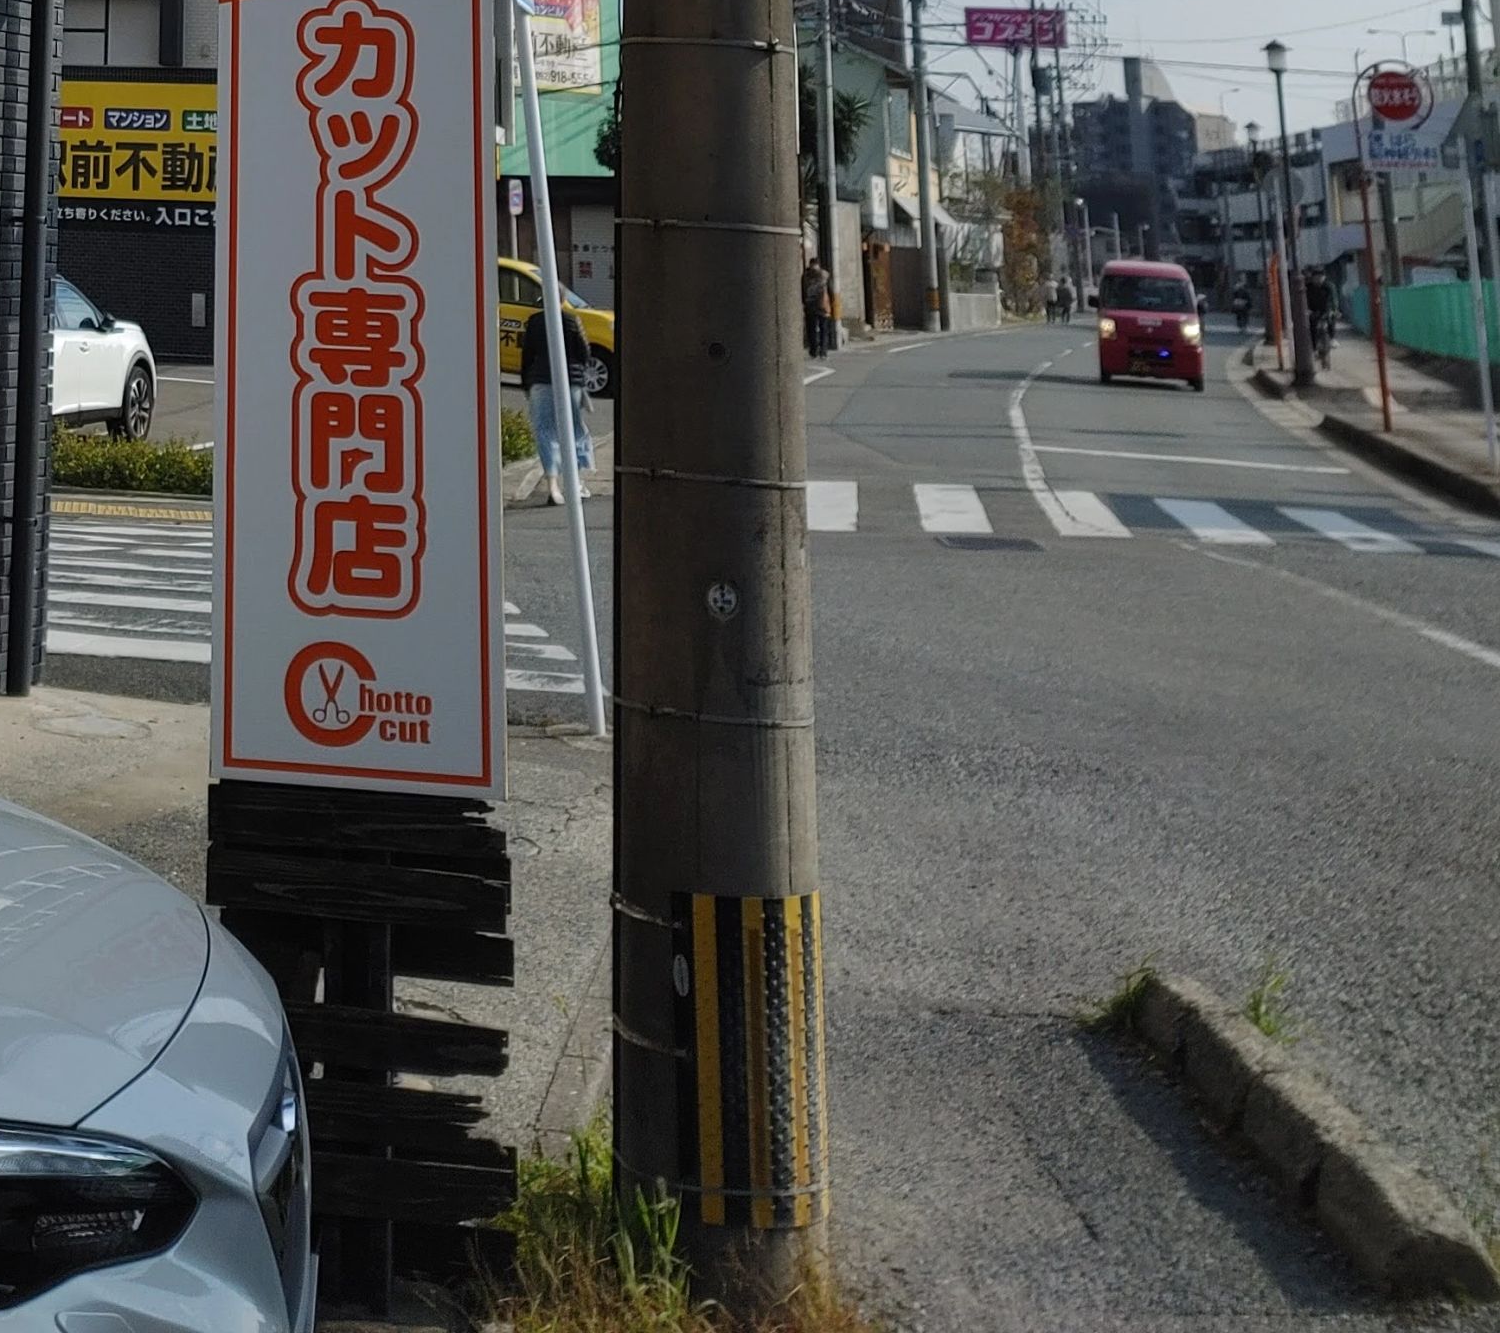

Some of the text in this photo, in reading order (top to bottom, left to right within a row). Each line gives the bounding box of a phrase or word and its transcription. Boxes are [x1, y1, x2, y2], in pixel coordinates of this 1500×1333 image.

[60, 109, 91, 127] ート
[106, 110, 168, 129] マンション
[303, 5, 412, 603] カット専門店
[379, 719, 431, 744] cut
